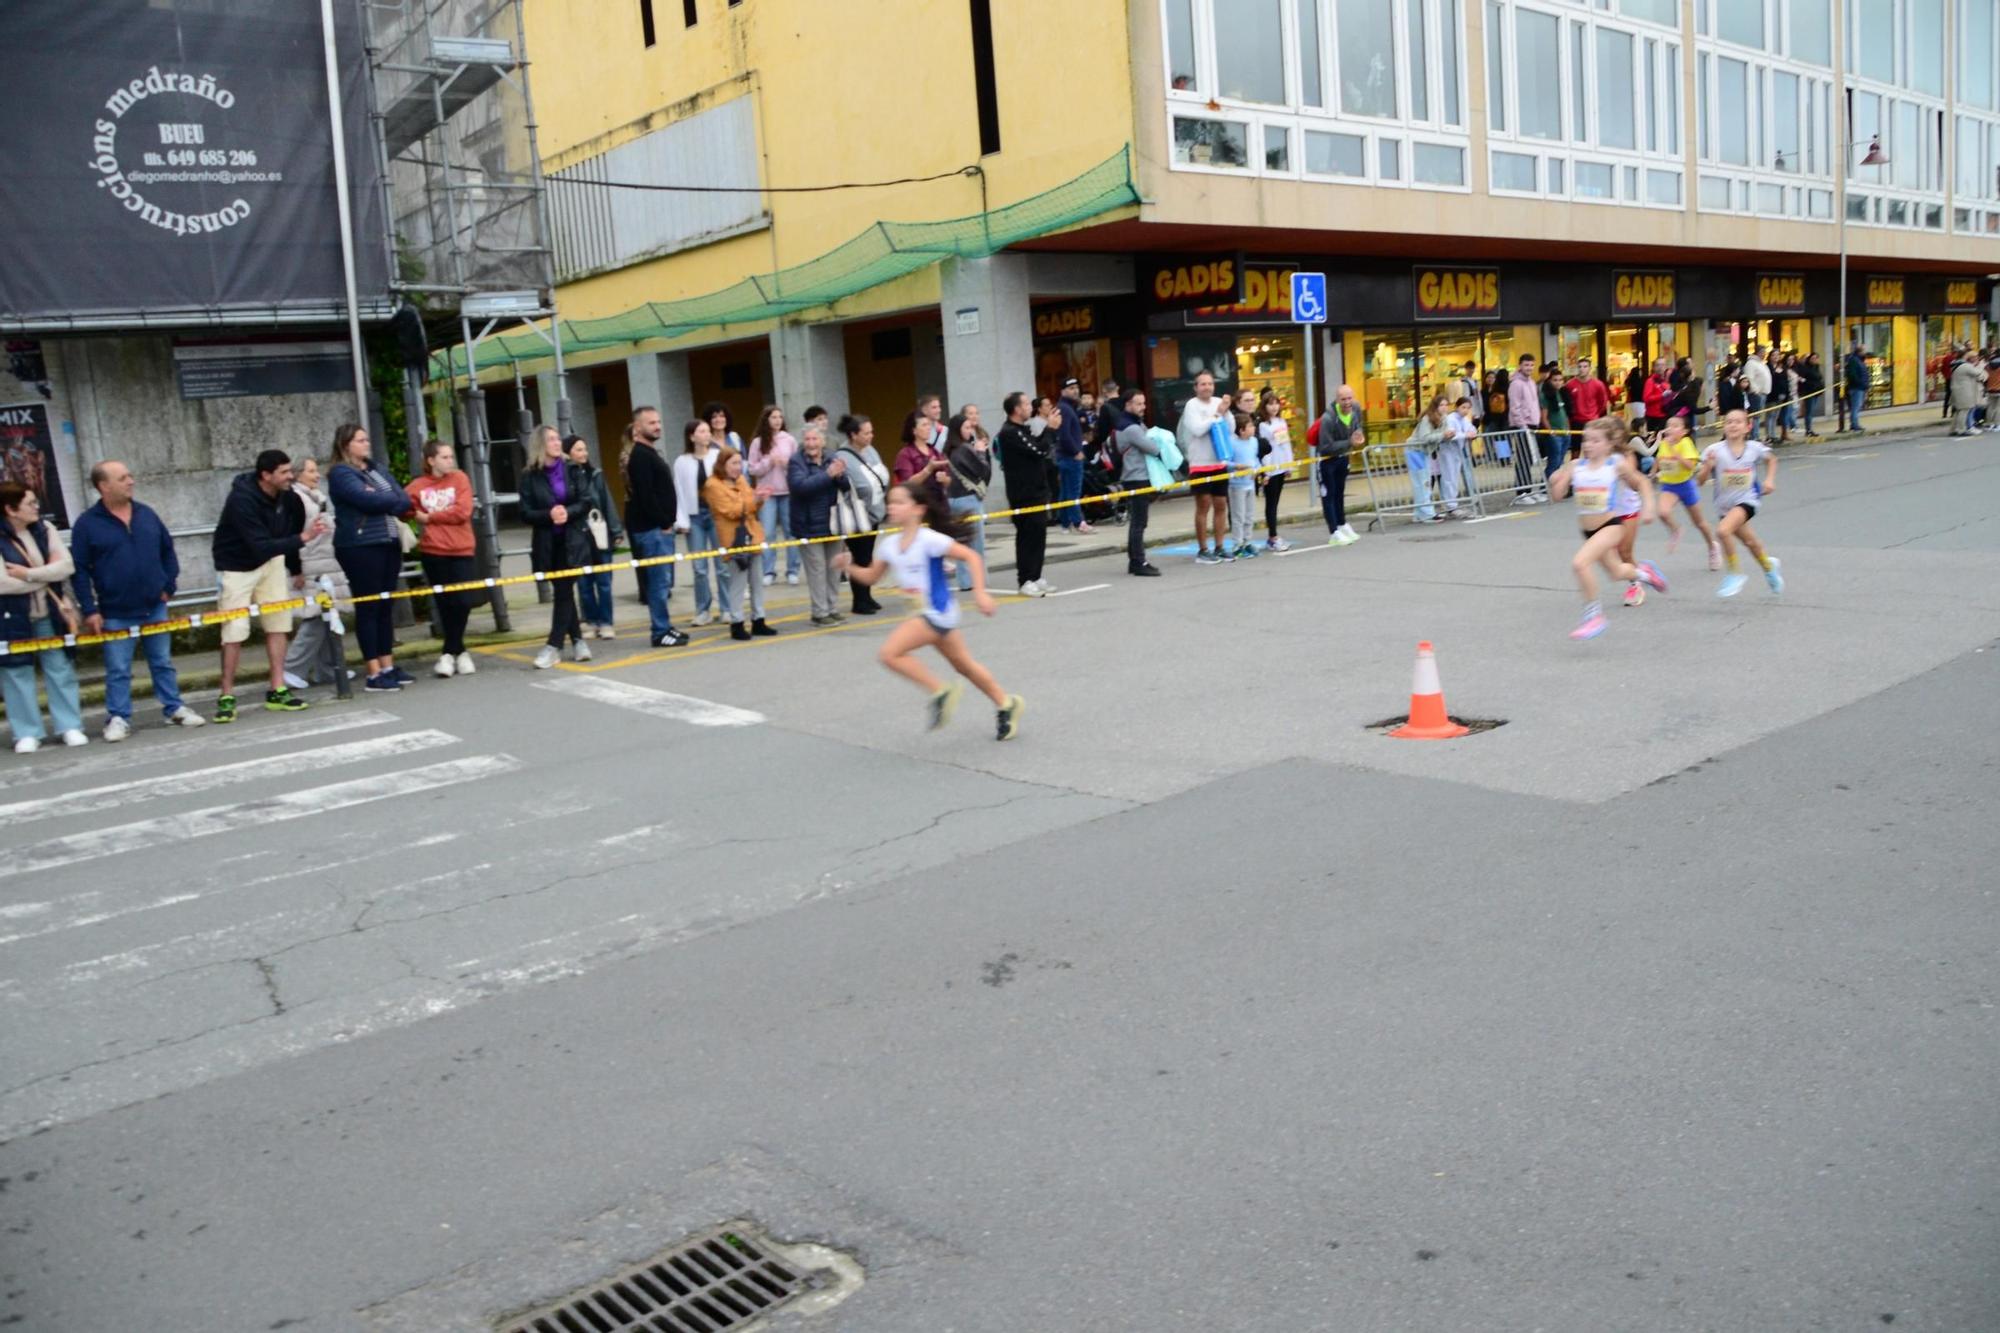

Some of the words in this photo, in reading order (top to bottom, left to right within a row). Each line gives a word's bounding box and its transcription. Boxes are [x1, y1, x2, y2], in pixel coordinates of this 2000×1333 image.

[105, 65, 235, 118] medraño
[158, 123, 204, 144] BUEU
[168, 149, 196, 166] 649
[199, 149, 227, 166] 685
[229, 149, 257, 166] 206
[127, 170, 282, 184] diegomedranho@yahoo.es
[1155, 260, 1235, 298] GADIS
[1419, 272, 1497, 310] GADIS
[1616, 275, 1674, 308] GADIS
[1759, 278, 1804, 307] GADIS
[1869, 280, 1904, 304] GADIS
[1035, 308, 1092, 335] GADIS
